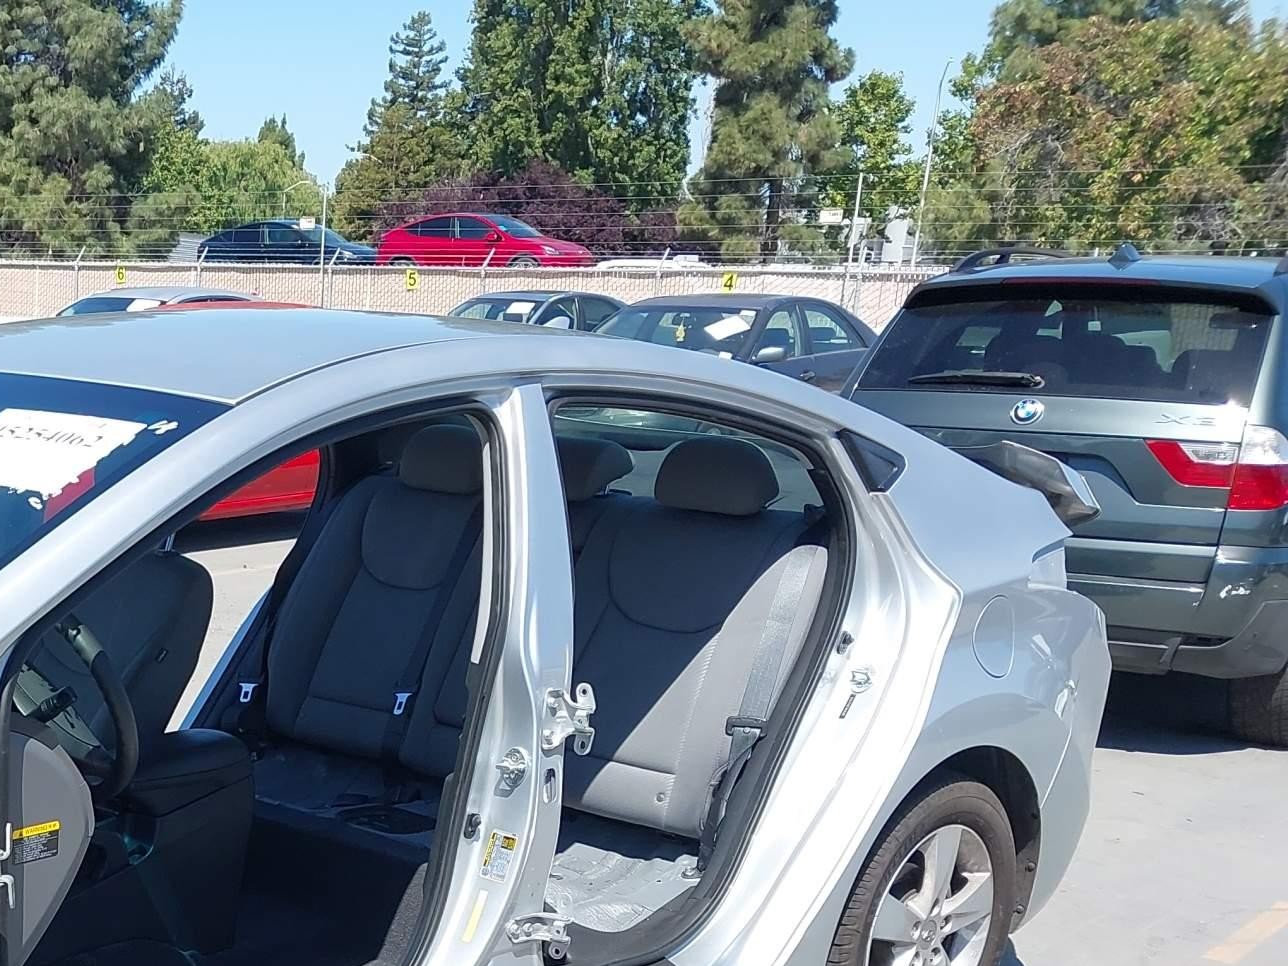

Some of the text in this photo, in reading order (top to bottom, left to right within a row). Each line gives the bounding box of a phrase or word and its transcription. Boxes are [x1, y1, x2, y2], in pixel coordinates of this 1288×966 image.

[117, 266, 125, 281] 6
[408, 271, 417, 287] 5
[723, 274, 734, 291] 4
